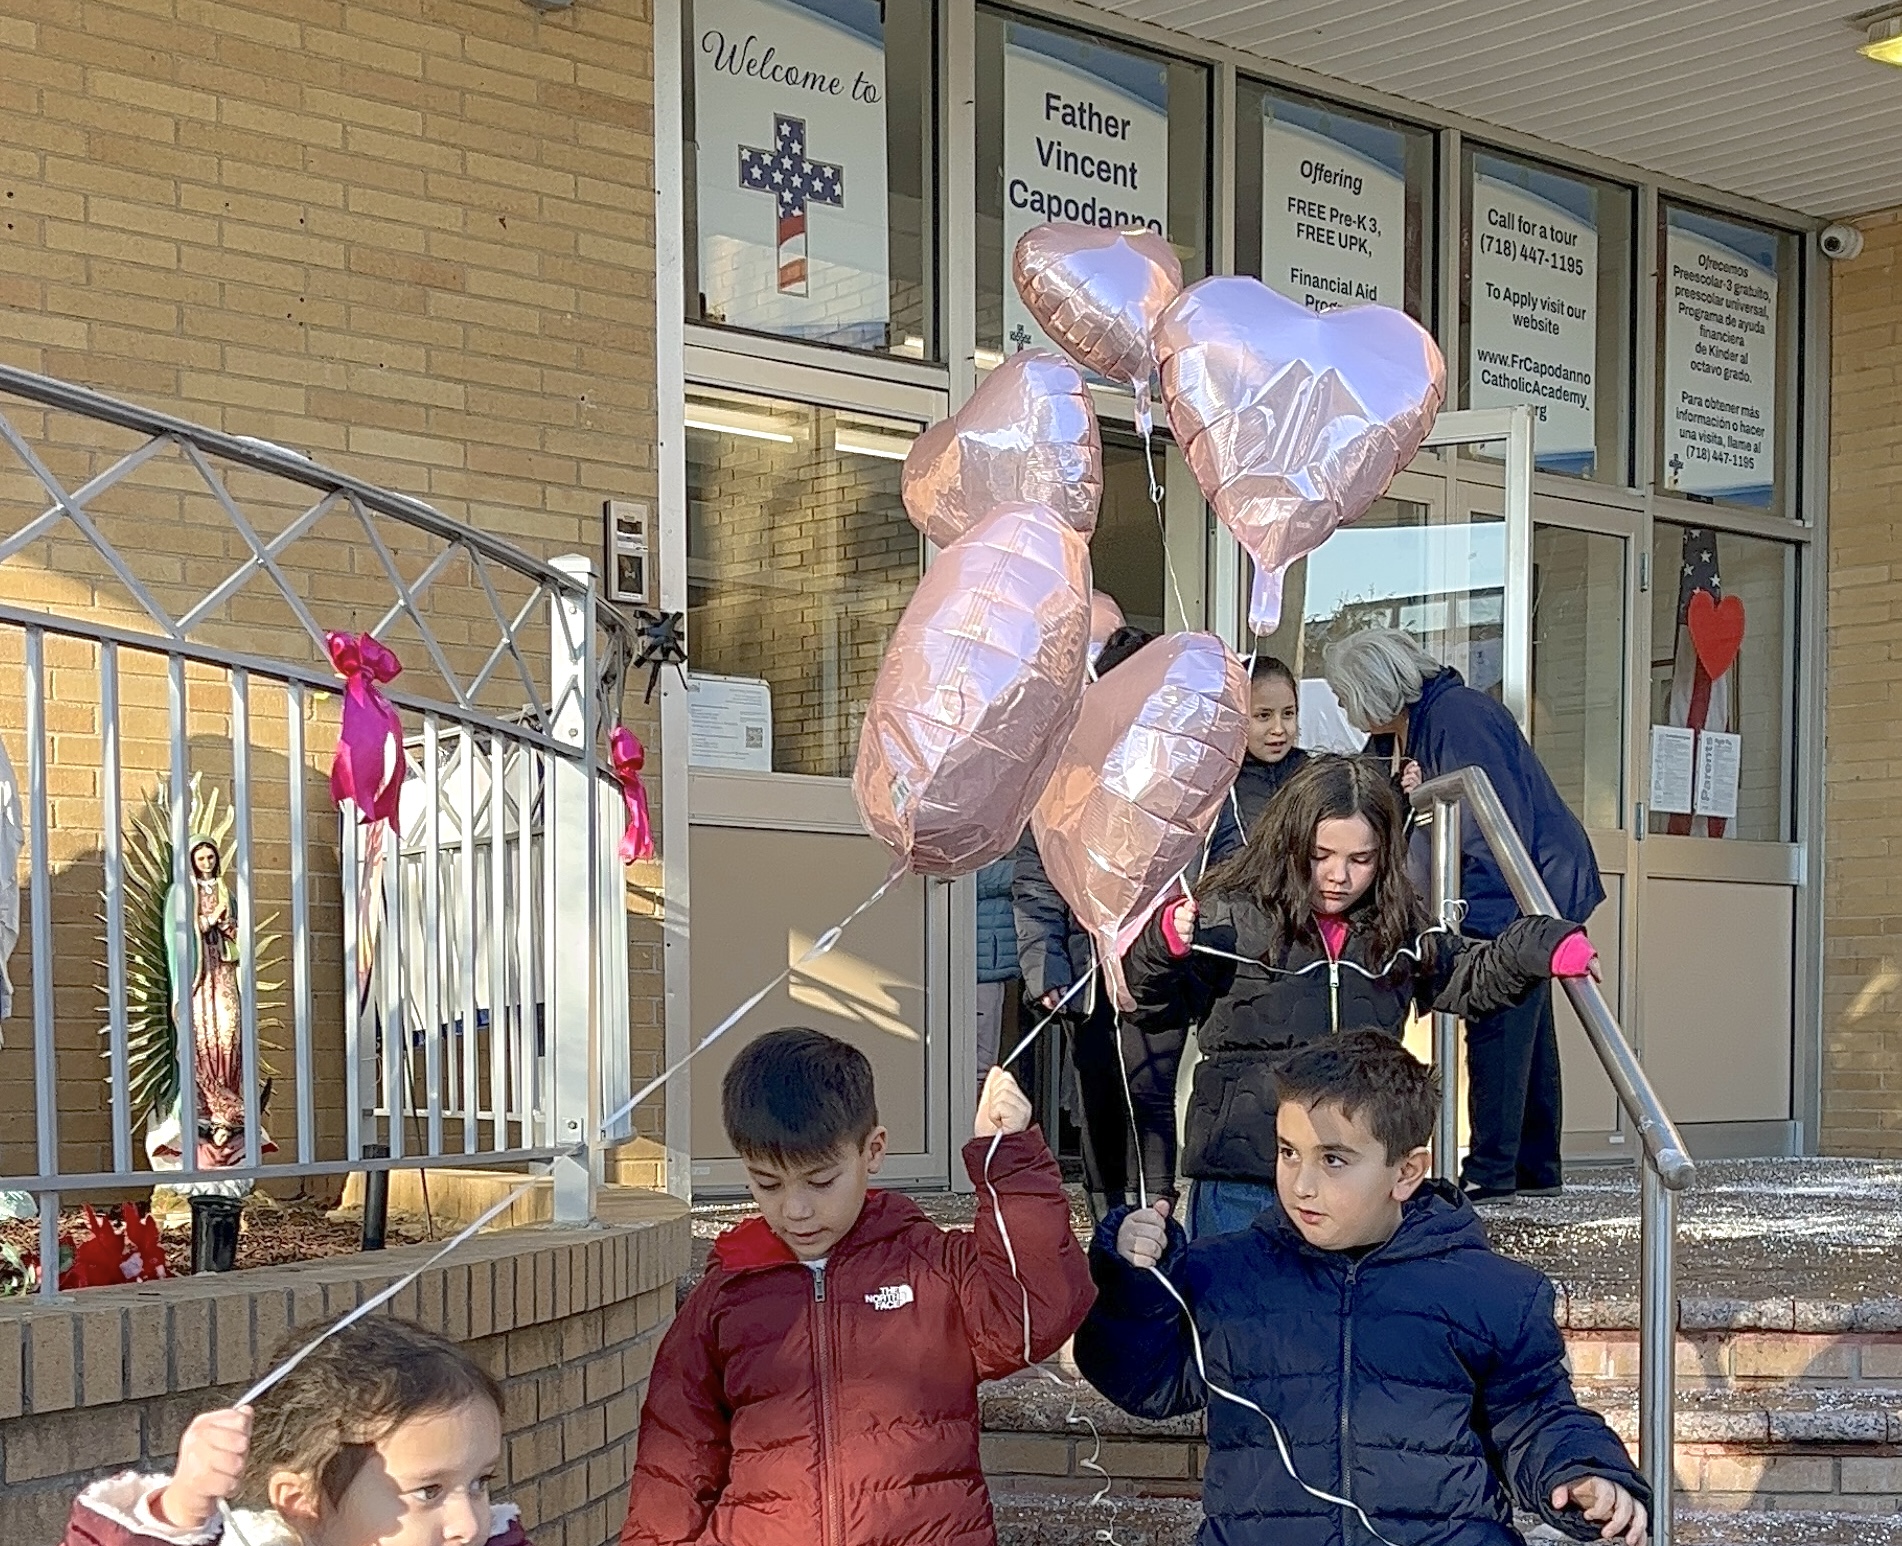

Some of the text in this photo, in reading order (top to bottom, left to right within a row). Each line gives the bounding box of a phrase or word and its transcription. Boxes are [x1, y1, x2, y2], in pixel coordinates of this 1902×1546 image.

[702, 30, 881, 103] Welcome to
[1045, 92, 1130, 140] Father
[1035, 137, 1138, 190] Vincent
[1301, 160, 1363, 195] Offering
[1288, 197, 1326, 221] FREE
[1297, 223, 1372, 258] FREE UPK,
[1488, 208, 1578, 247] Call for a tour
[1480, 233, 1583, 276] (718) 447-1195
[1698, 254, 1748, 278] Ofrecemos
[1291, 268, 1377, 301] Financial Aid
[1486, 282, 1586, 320] To Apply visit our
[1673, 265, 1771, 304] Preescolar-3 gratuito,
[1675, 286, 1769, 320] preescolar universal,
[1678, 302, 1765, 335] Programa de ayuda
[1512, 314, 1560, 335] website
[1699, 324, 1745, 347] financiera
[1477, 349, 1591, 385] www.FrCapodanno
[1695, 341, 1748, 365] de Kinder al
[1690, 360, 1752, 384] octavo grado.
[1534, 405, 1547, 422] rg
[1681, 390, 1760, 419] Para obtener más
[1679, 428, 1762, 454] una visita, llame al
[1732, 422, 1738, 432] o
[1740, 420, 1765, 437] hacer
[1686, 445, 1755, 470] (718) 447-1195
[1701, 736, 1713, 802] Parents
